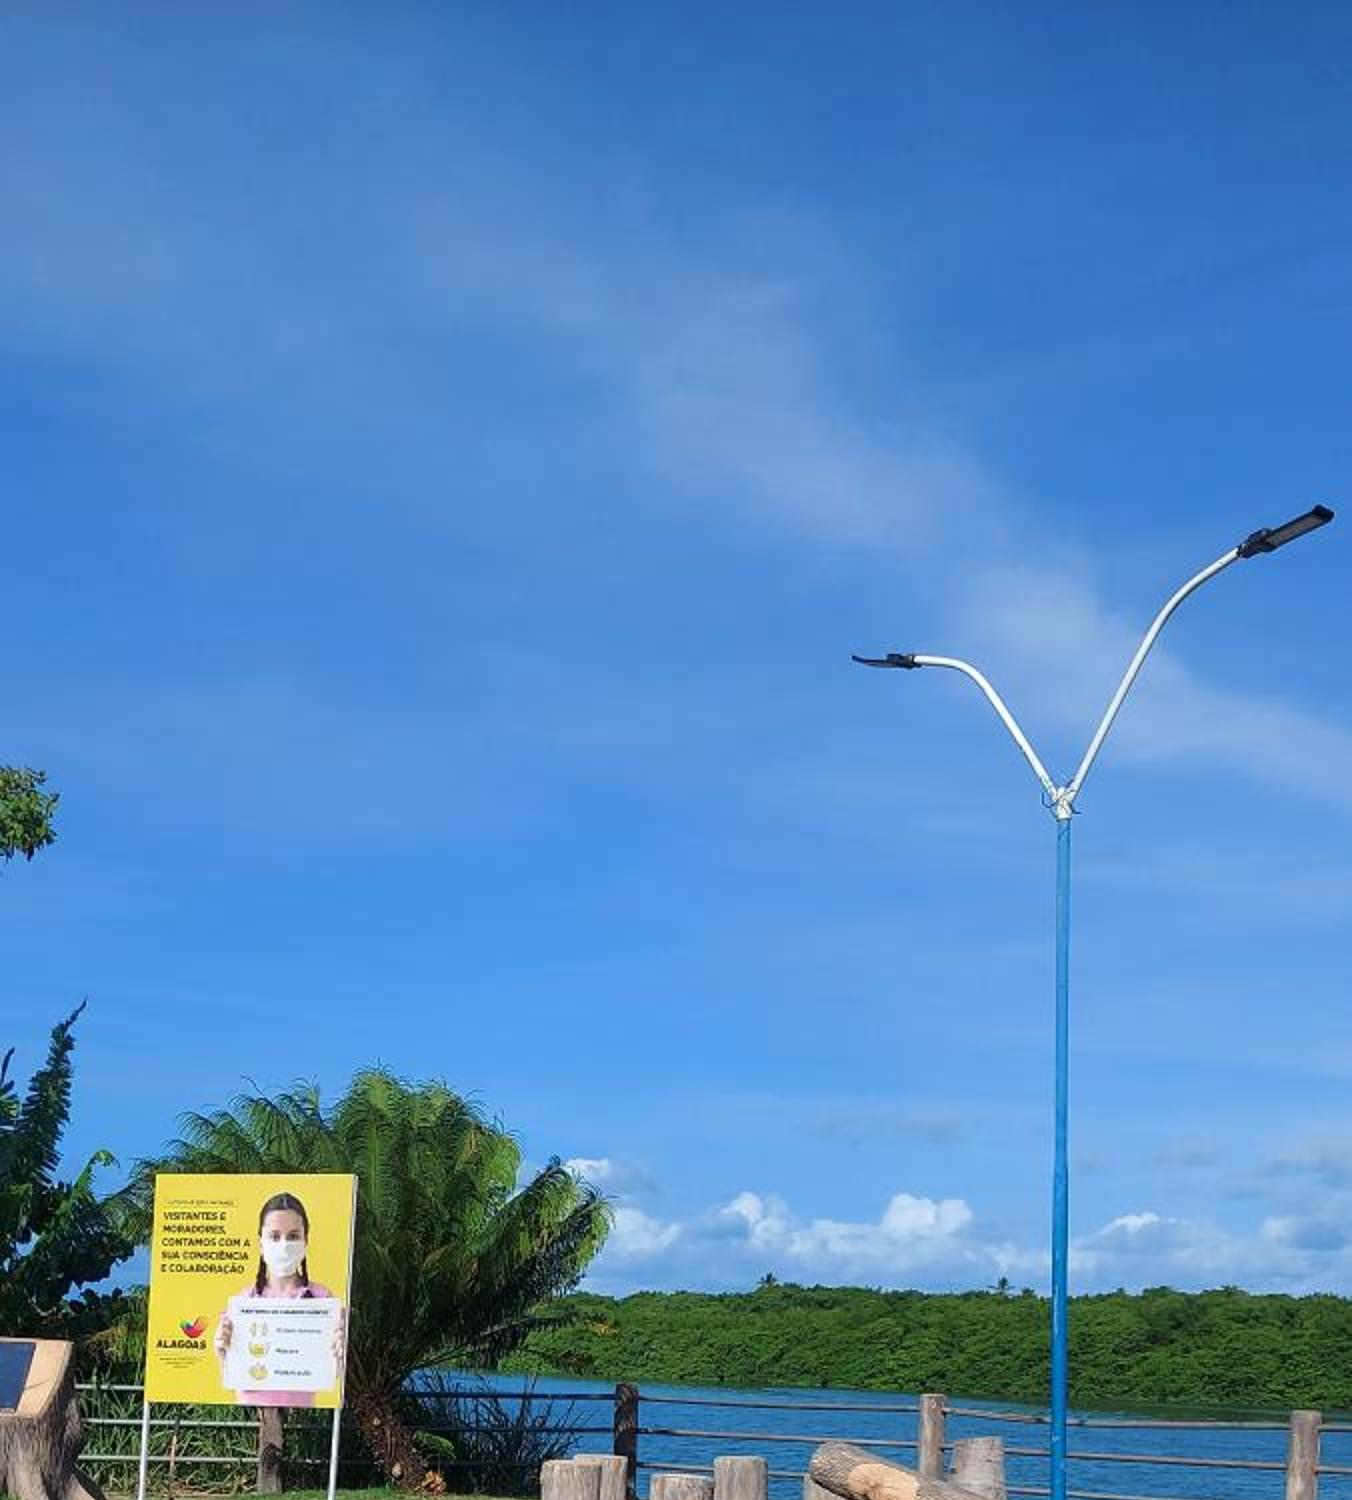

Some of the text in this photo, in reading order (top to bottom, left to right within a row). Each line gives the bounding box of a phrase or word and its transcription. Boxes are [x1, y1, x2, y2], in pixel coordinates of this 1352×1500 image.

[163, 1211, 227, 1221] VISITANTES E
[163, 1225, 226, 1235] MORADORES,
[161, 1237, 251, 1247] CONTAMOS COM A
[161, 1250, 249, 1260] SUA CONSCIÊNCIA
[161, 1262, 245, 1274] E COLABORAÇÃO
[156, 1339, 207, 1350] ALAGOAS
